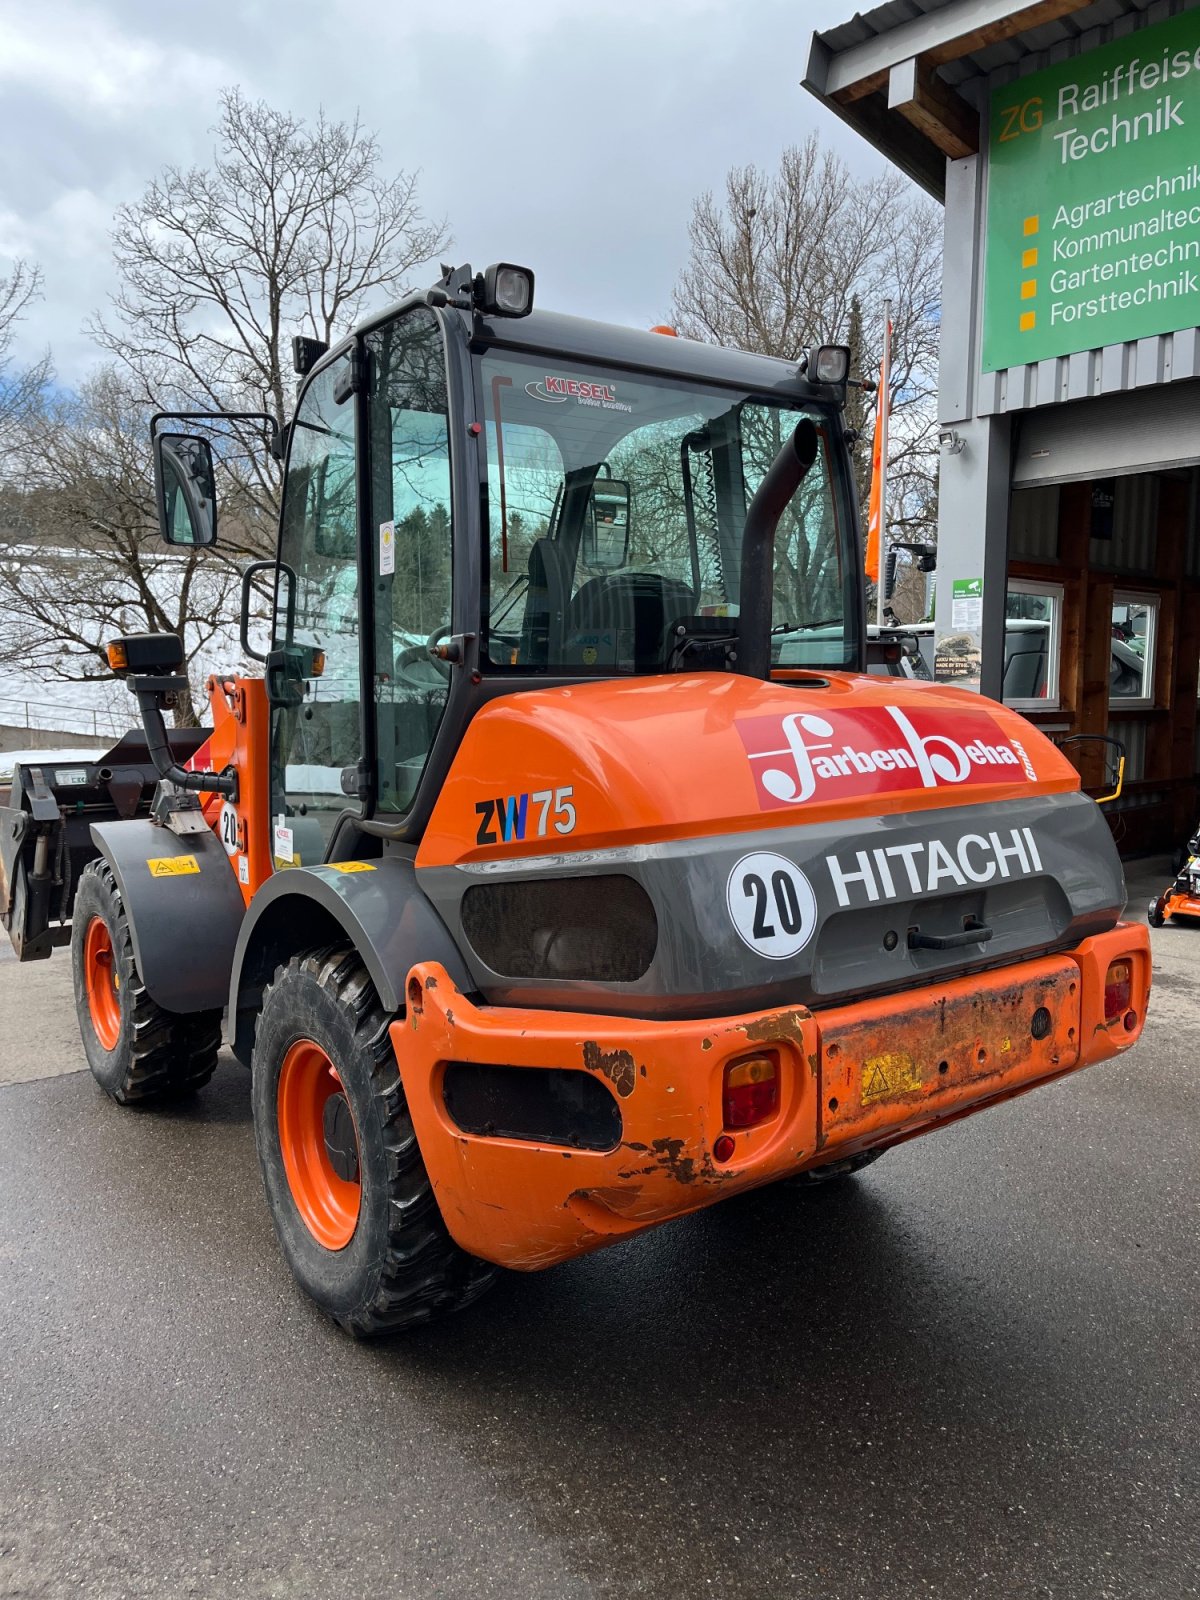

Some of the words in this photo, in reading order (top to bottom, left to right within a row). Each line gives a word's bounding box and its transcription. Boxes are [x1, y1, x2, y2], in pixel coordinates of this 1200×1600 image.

[999, 97, 1043, 142] ZG
[1053, 95, 1185, 164] Technik
[1053, 206, 1200, 262] Kommunaltec
[1050, 240, 1200, 294] Gartentechn
[1050, 270, 1199, 326] Forsttechnik
[545, 376, 615, 401] KIESEL
[223, 811, 236, 846] 20
[826, 827, 1043, 907] HITACHI
[742, 869, 803, 940] 20
